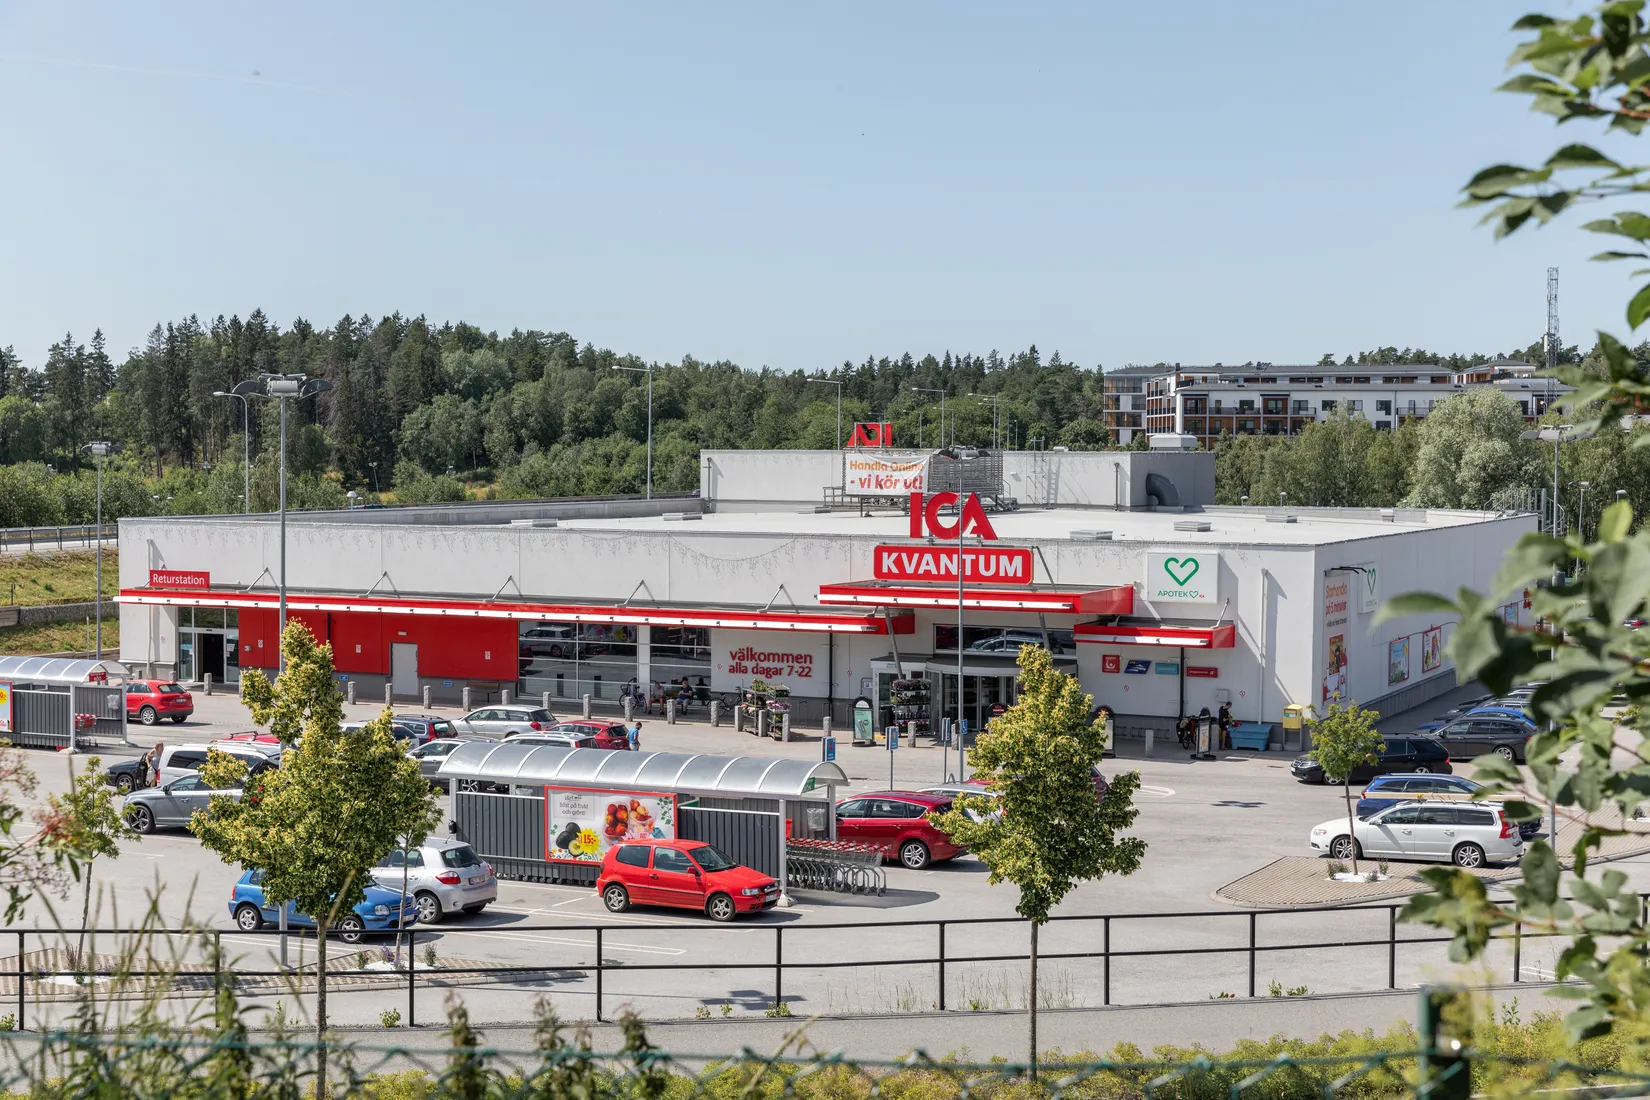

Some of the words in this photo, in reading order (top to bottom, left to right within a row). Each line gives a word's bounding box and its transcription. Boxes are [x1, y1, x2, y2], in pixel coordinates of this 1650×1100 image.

[850, 460, 888, 471] Handla
[890, 461, 924, 472] Online
[859, 474, 872, 489] vi
[875, 474, 900, 490] kör
[903, 476, 923, 490] ut!
[910, 492, 998, 540] ICA
[882, 552, 1022, 577] KVANTUM
[153, 574, 204, 584] Returstation
[730, 647, 812, 664] välkommen
[728, 662, 748, 674] alla
[752, 663, 783, 678] dagar
[786, 666, 812, 677] 7-22
[584, 834, 596, 844] 15:-
